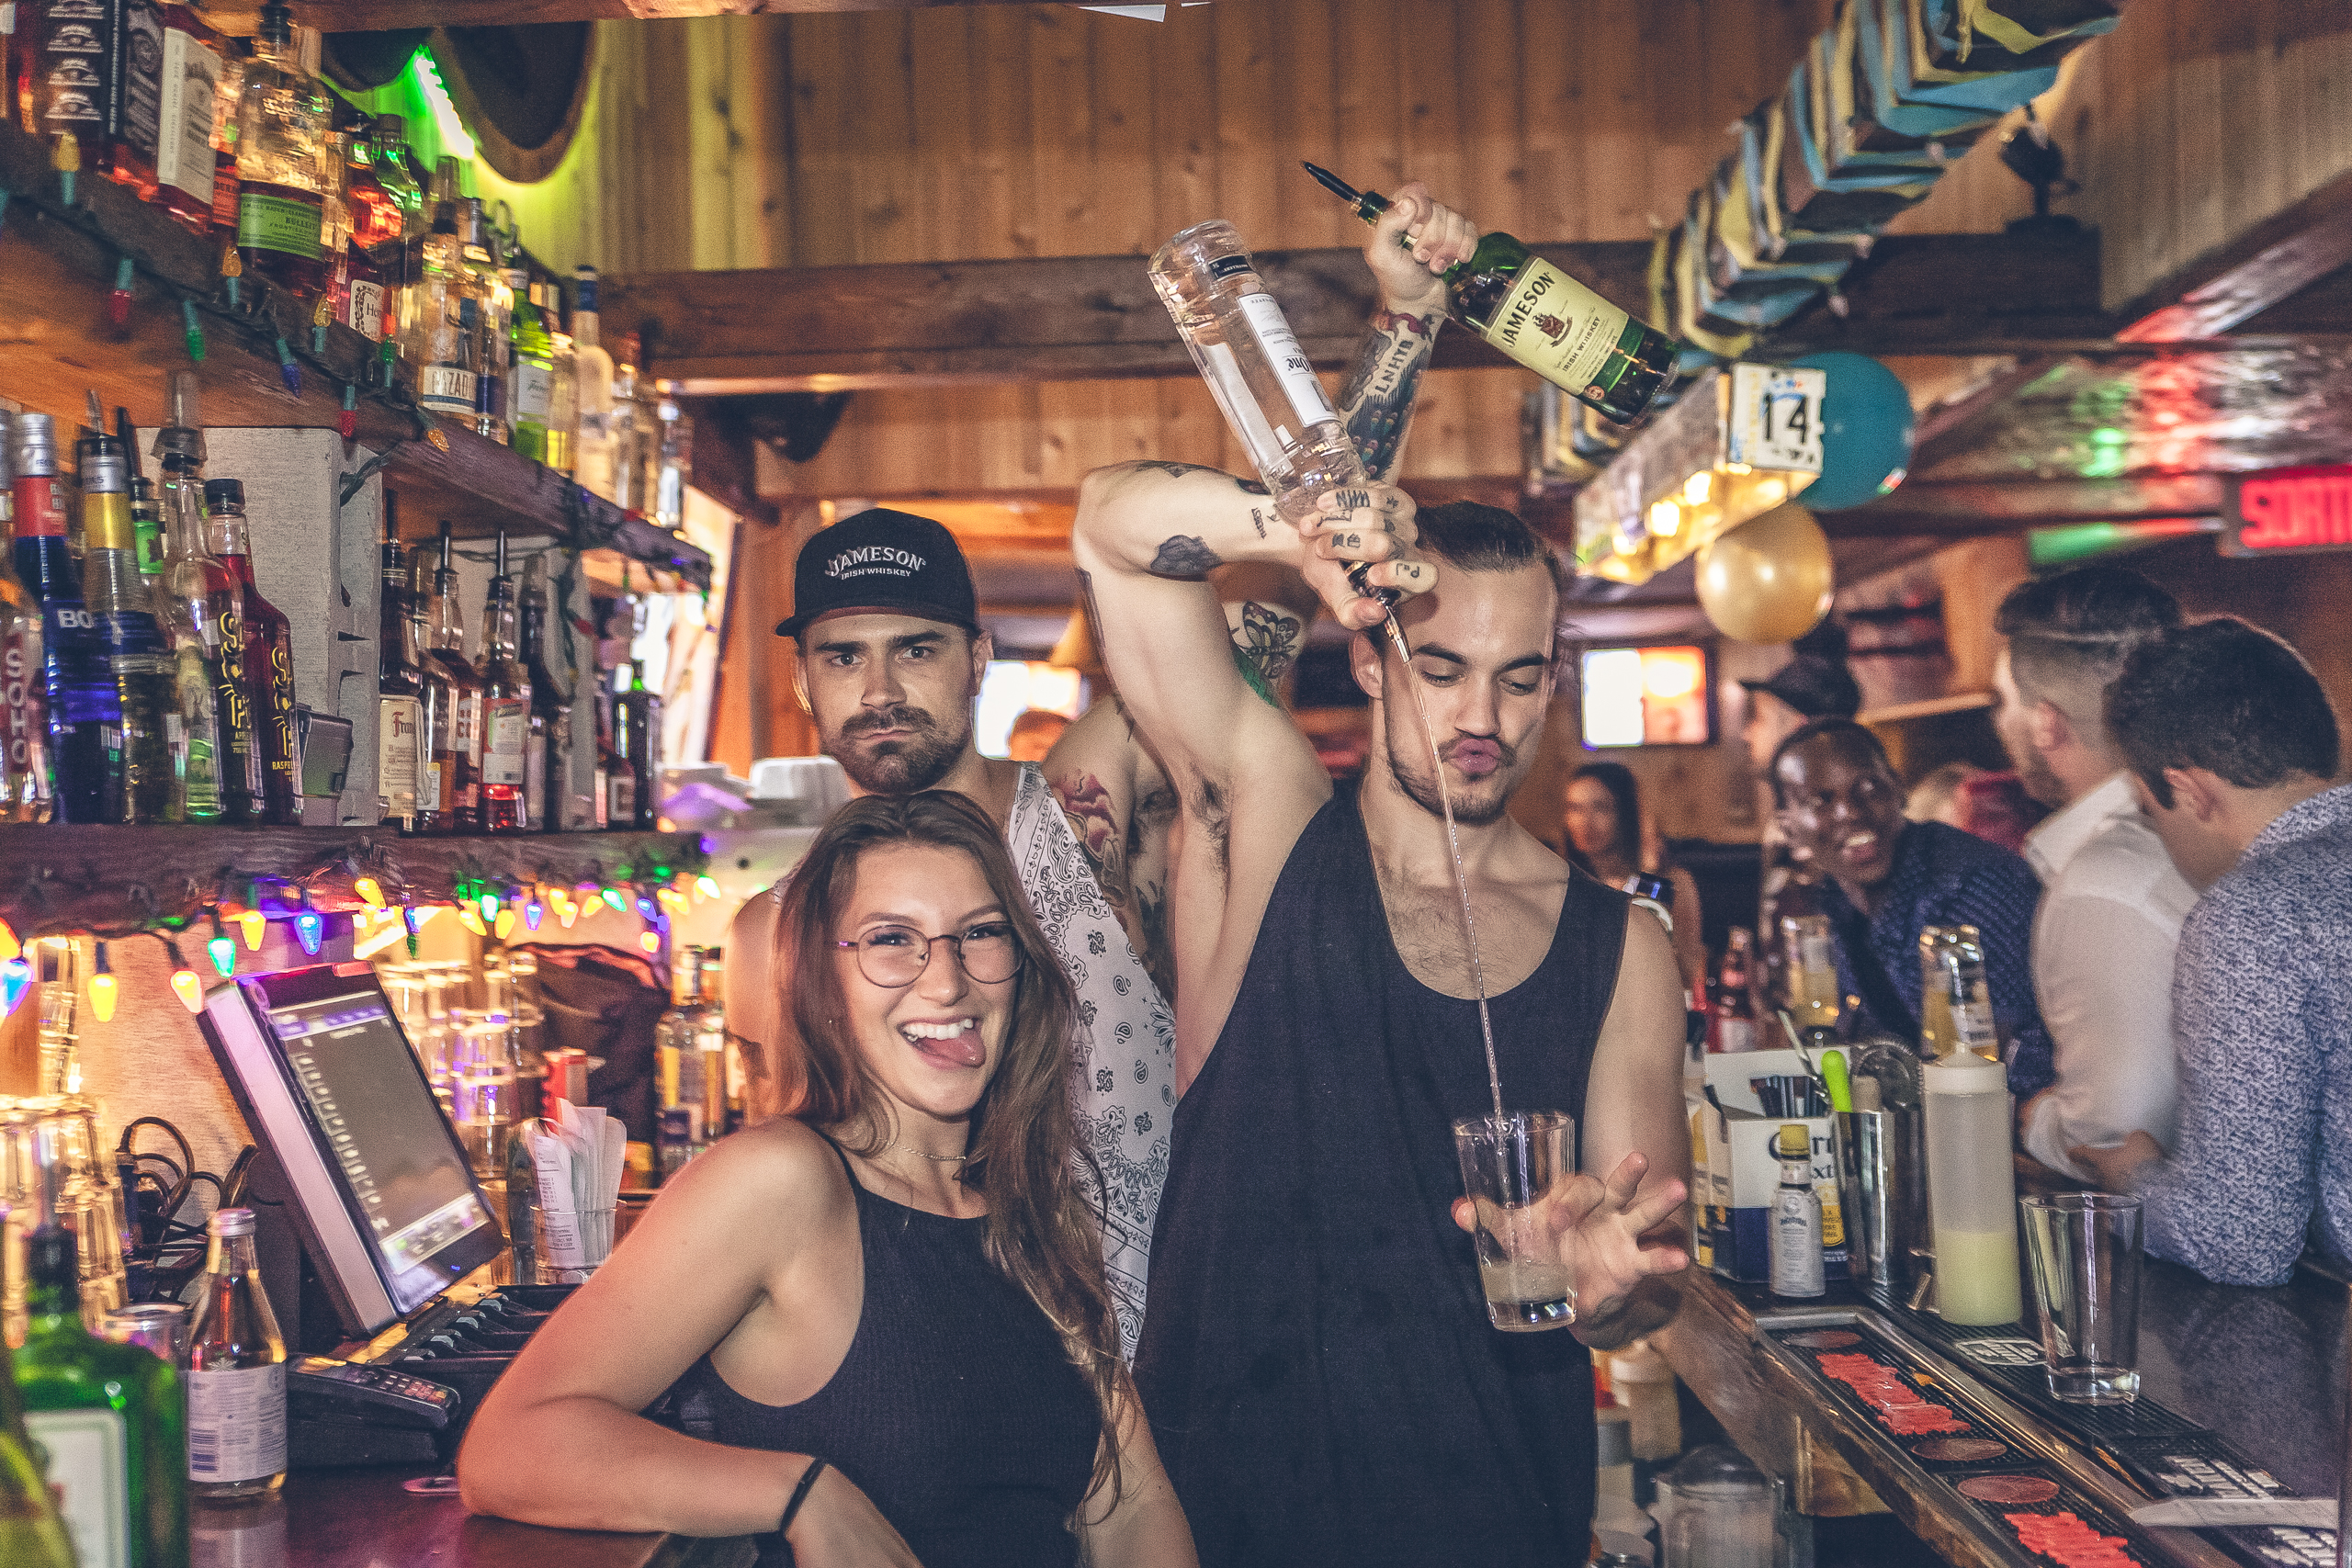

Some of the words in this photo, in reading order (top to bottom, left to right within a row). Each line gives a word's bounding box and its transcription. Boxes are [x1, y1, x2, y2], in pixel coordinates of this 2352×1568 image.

[1501, 271, 1556, 348] JAMESON
[1562, 353, 1579, 372] IRISH
[1764, 393, 1808, 445] 14
[824, 546, 924, 578] JAMESON
[842, 569, 865, 580] IRISH
[866, 568, 911, 577] WHISKEY
[58, 609, 94, 629] BO
[6, 648, 28, 764] SOHO
